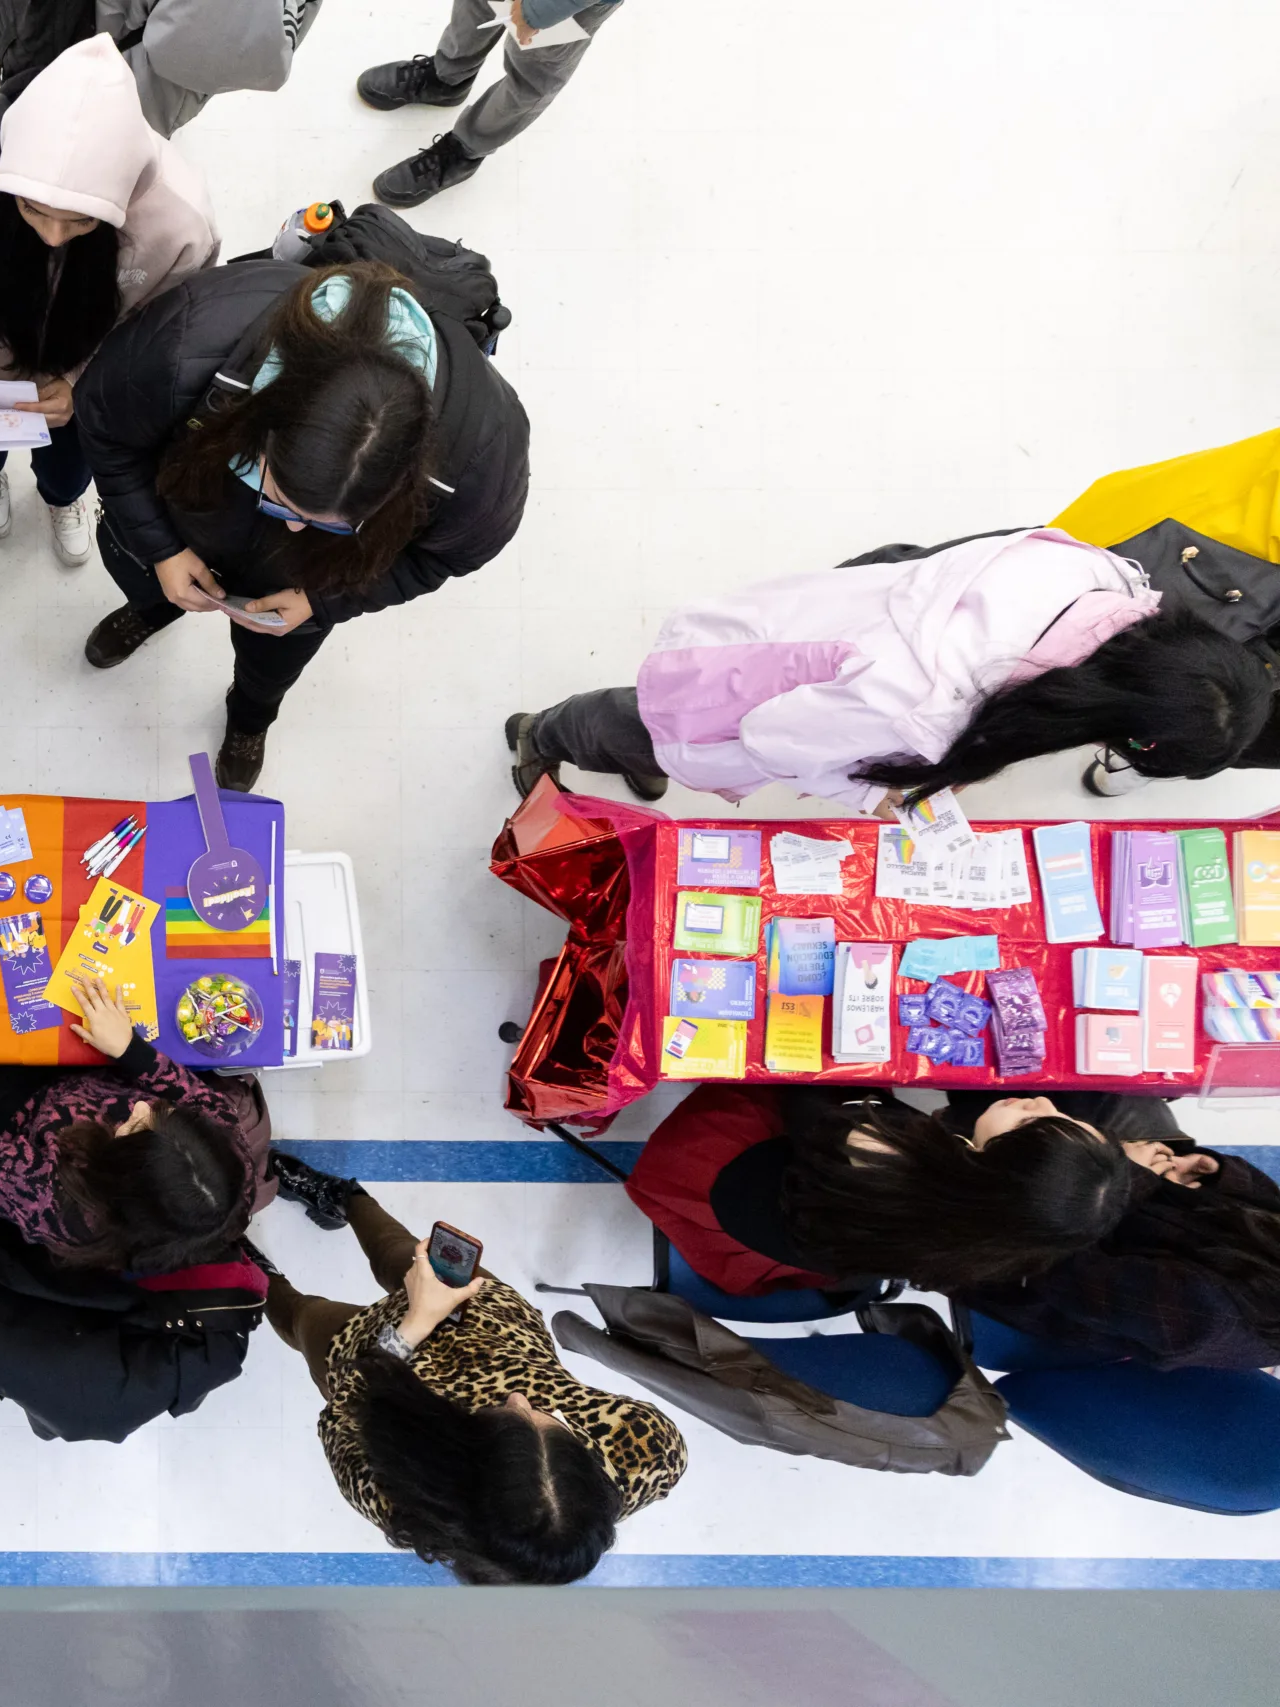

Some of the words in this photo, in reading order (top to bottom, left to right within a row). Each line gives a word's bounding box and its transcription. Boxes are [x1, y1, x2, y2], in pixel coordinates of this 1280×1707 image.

[116, 268, 148, 285] MORE
[848, 994, 860, 1002] ITS
[861, 994, 885, 1003] SOBRE
[846, 1004, 885, 1013] HABLEMOS
